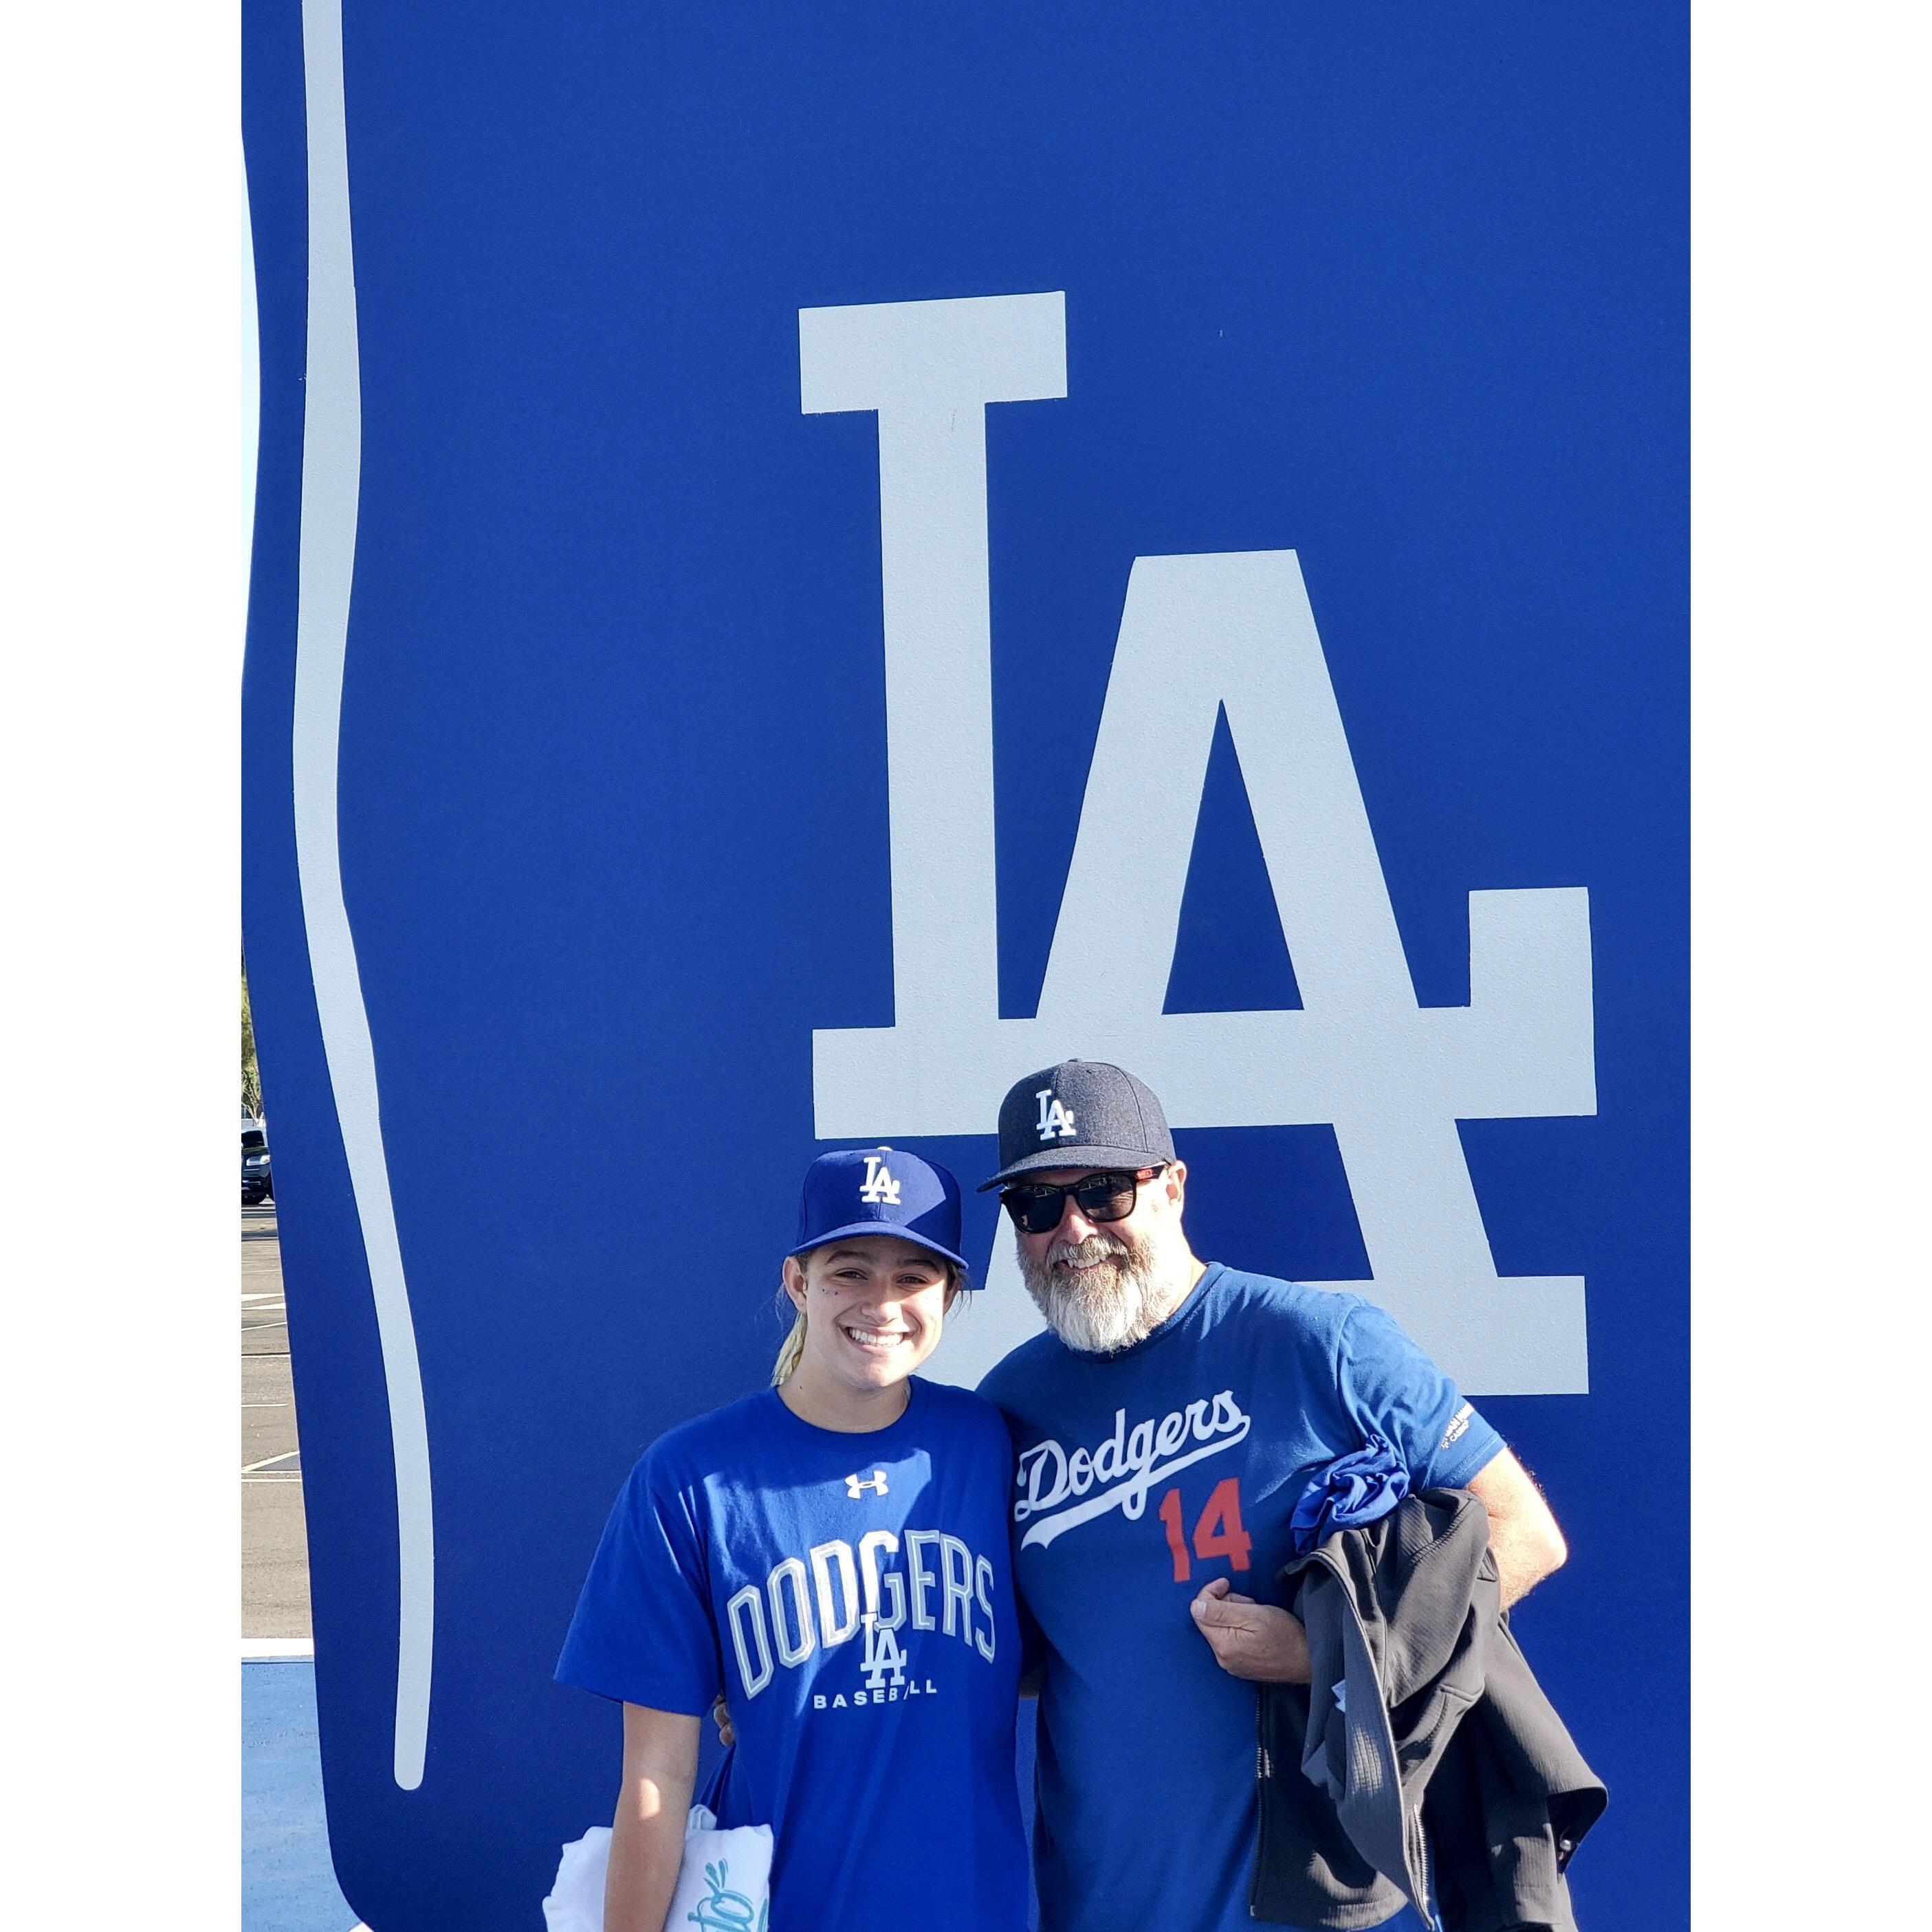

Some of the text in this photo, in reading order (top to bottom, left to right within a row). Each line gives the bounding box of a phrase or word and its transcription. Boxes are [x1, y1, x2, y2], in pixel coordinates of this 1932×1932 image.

[799, 291, 1598, 1396] LA
[1035, 1088, 1077, 1141] LA
[859, 1156, 901, 1205] LA
[1014, 1390, 1251, 1551] Dodgers
[1159, 1476, 1253, 1583] 14
[727, 1530, 996, 1700] DODGERS
[859, 1612, 908, 1689] LA
